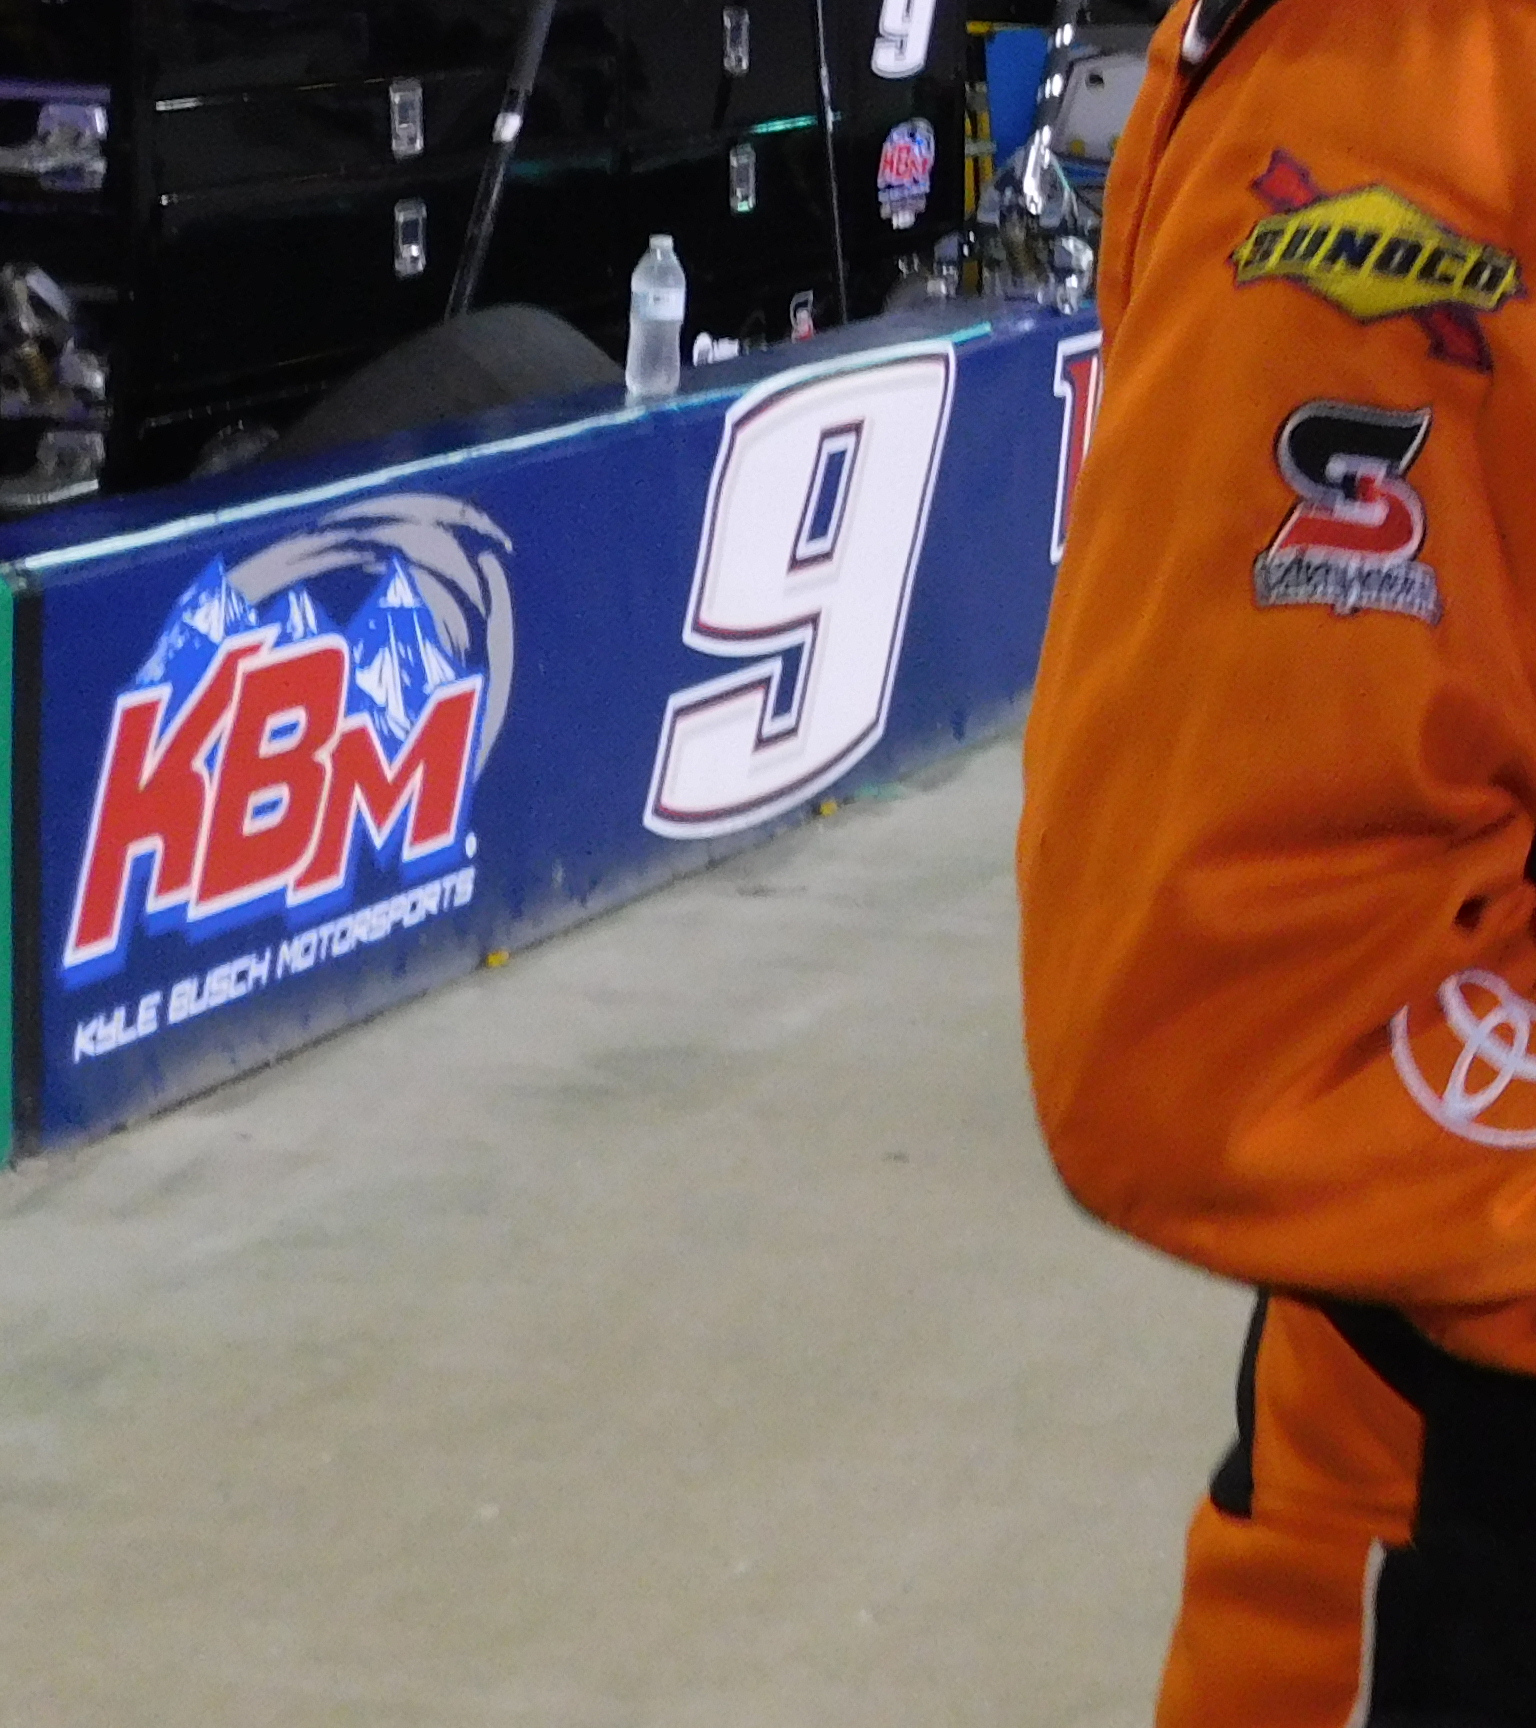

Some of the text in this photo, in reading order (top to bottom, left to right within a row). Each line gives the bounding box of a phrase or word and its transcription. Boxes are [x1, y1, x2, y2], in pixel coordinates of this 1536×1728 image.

[643, 340, 956, 840] 9
[62, 622, 484, 968] KBM
[73, 866, 476, 1064] KYLE BUSCH MOTORSPORTS
